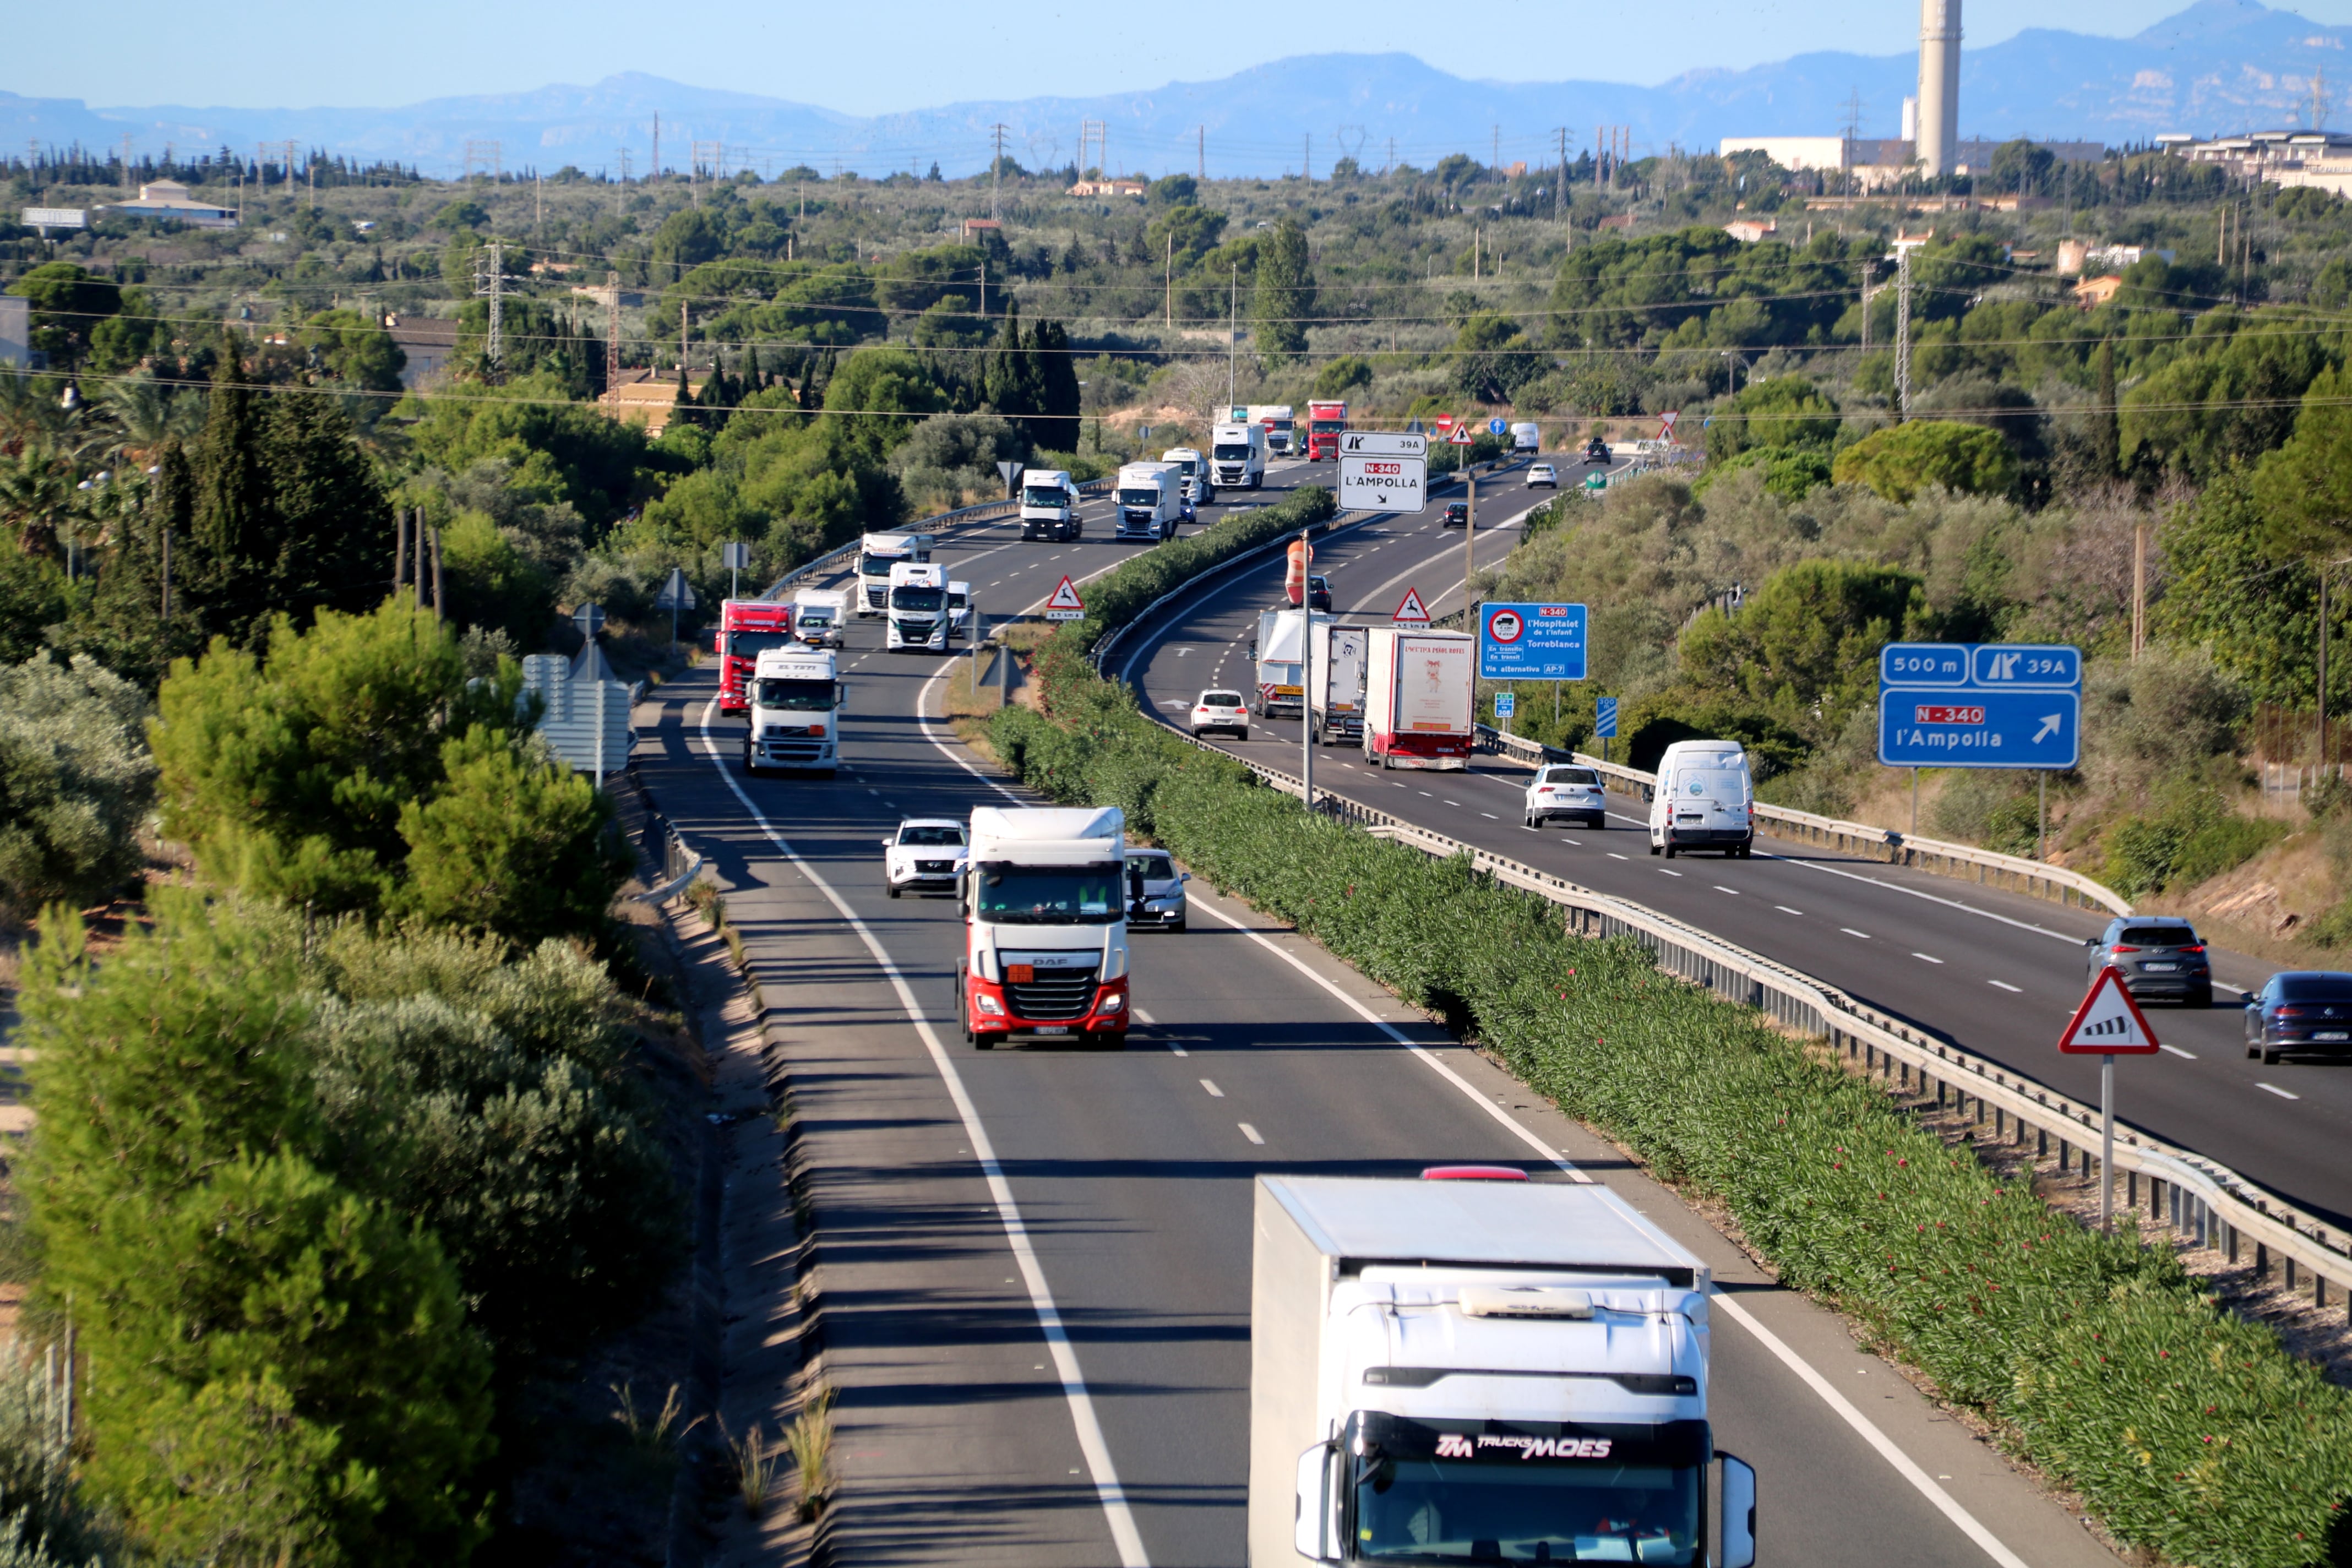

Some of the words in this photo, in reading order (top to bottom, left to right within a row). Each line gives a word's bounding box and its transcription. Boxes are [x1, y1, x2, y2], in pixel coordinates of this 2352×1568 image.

[1400, 440, 1419, 449] 39A
[1366, 464, 1399, 473] N-340
[1346, 476, 1418, 488] L'AMPOLLA
[1527, 619, 1579, 629] l'Hospitalet
[1527, 640, 1580, 648] Torreblanca
[1893, 657, 1936, 672] 500
[1942, 661, 1957, 673] m
[2026, 658, 2066, 674] 39A
[1896, 728, 2002, 750] l'Ampolla
[1435, 1434, 1473, 1458] TM
[1477, 1435, 1533, 1449] TRUCKS
[1521, 1437, 1612, 1460] MOES
